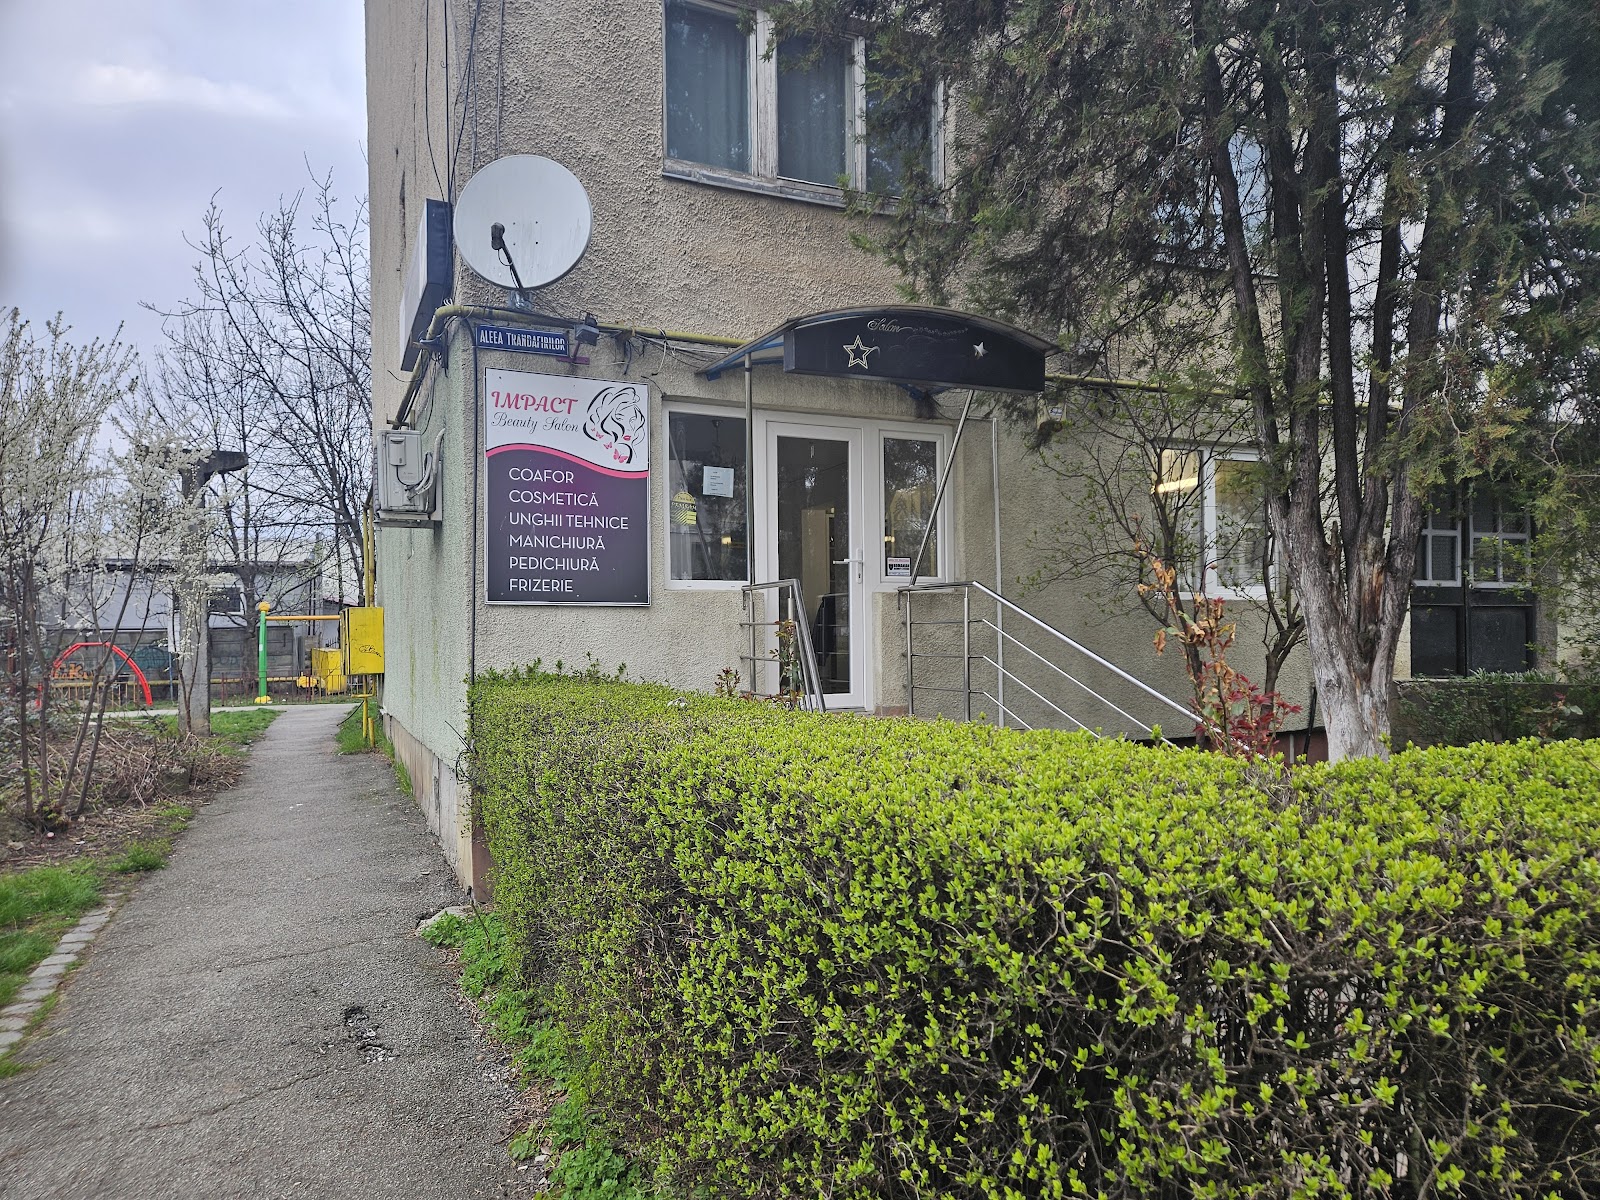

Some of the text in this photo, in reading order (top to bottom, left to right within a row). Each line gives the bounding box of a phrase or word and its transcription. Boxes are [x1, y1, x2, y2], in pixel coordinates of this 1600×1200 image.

[480, 329, 565, 351] ALEEA TRANDAFIRILOR
[491, 391, 578, 415] IMPACT
[491, 411, 579, 435] Beauty Salon
[508, 467, 574, 484] COAFOR
[508, 489, 599, 507] COSMETICĂ
[509, 511, 629, 530] UNGHII TEHNICE
[509, 534, 605, 550] MANICHIURĂ
[509, 556, 600, 572] PEDICHIURĂ
[509, 578, 574, 593] FRIZERIE
